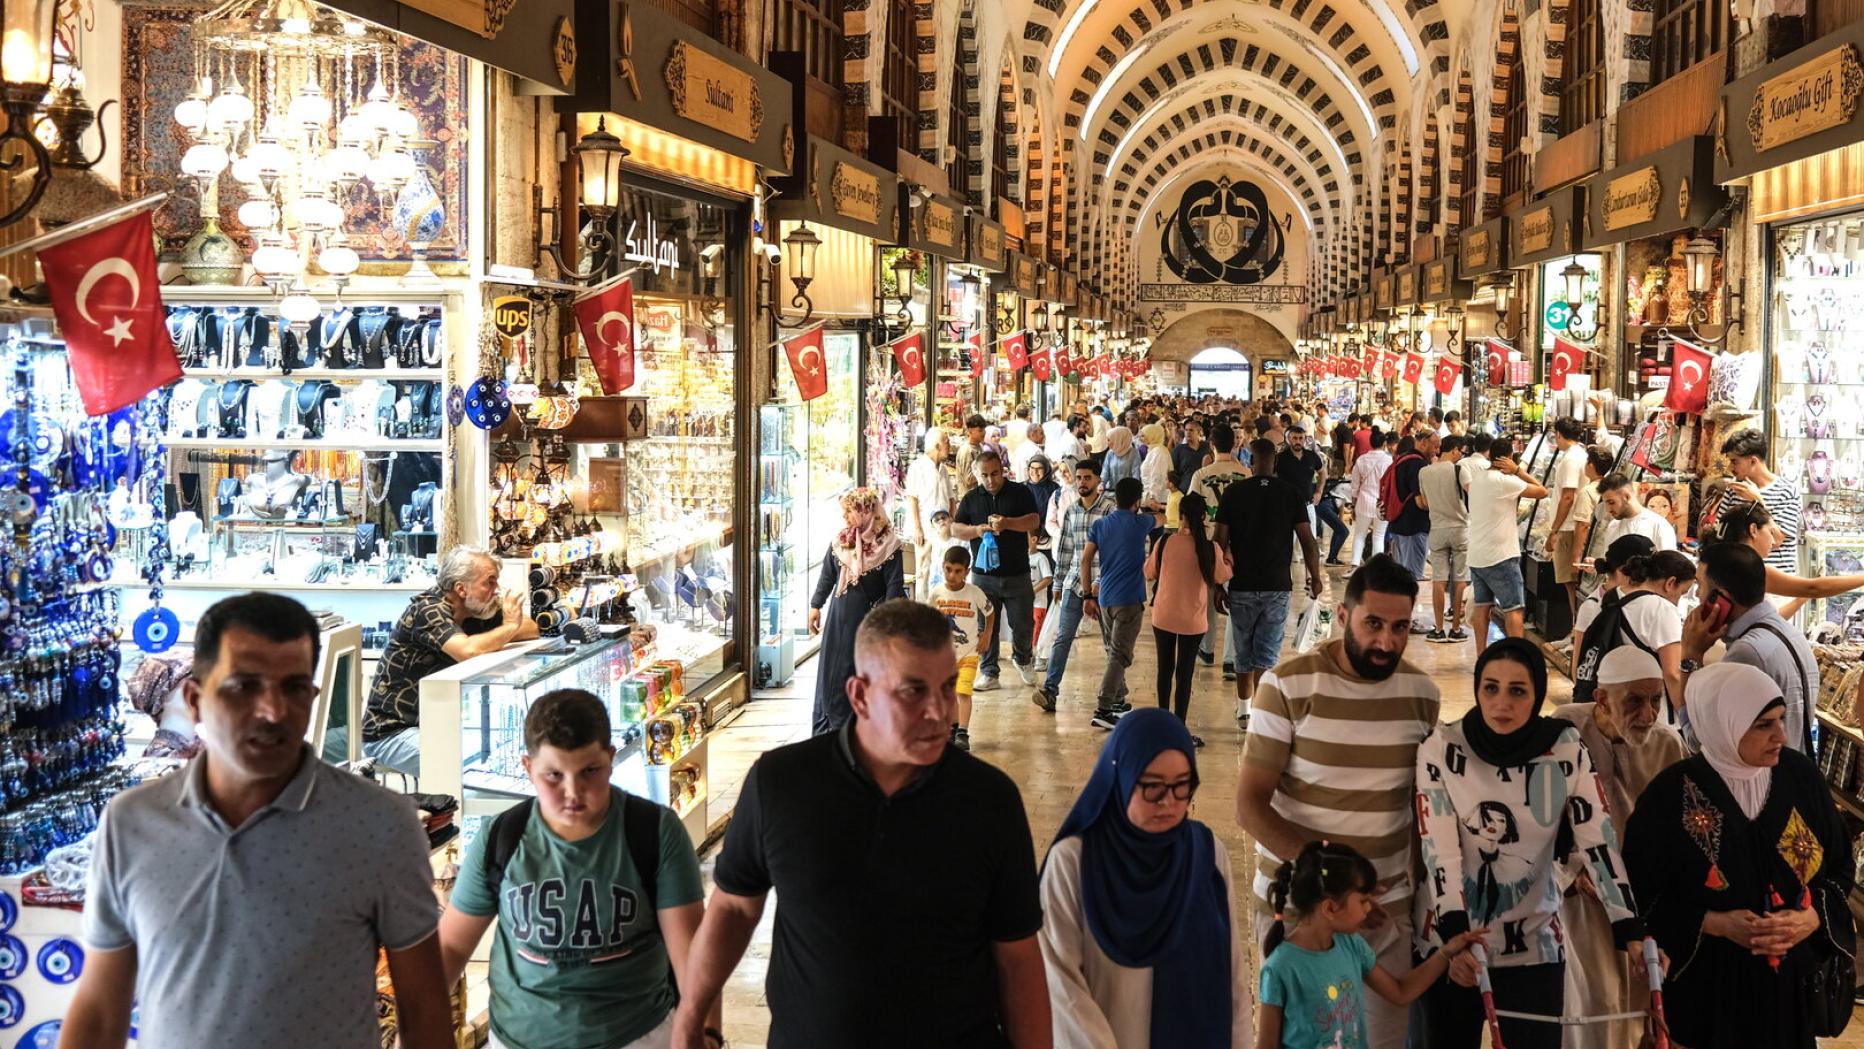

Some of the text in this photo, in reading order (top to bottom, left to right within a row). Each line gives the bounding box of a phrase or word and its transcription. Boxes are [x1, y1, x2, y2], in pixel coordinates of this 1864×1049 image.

[705, 79, 734, 114] Sultani
[1769, 70, 1834, 122] Kocaoğlu Gift
[496, 309, 528, 333] ups
[506, 877, 639, 949] USAP
